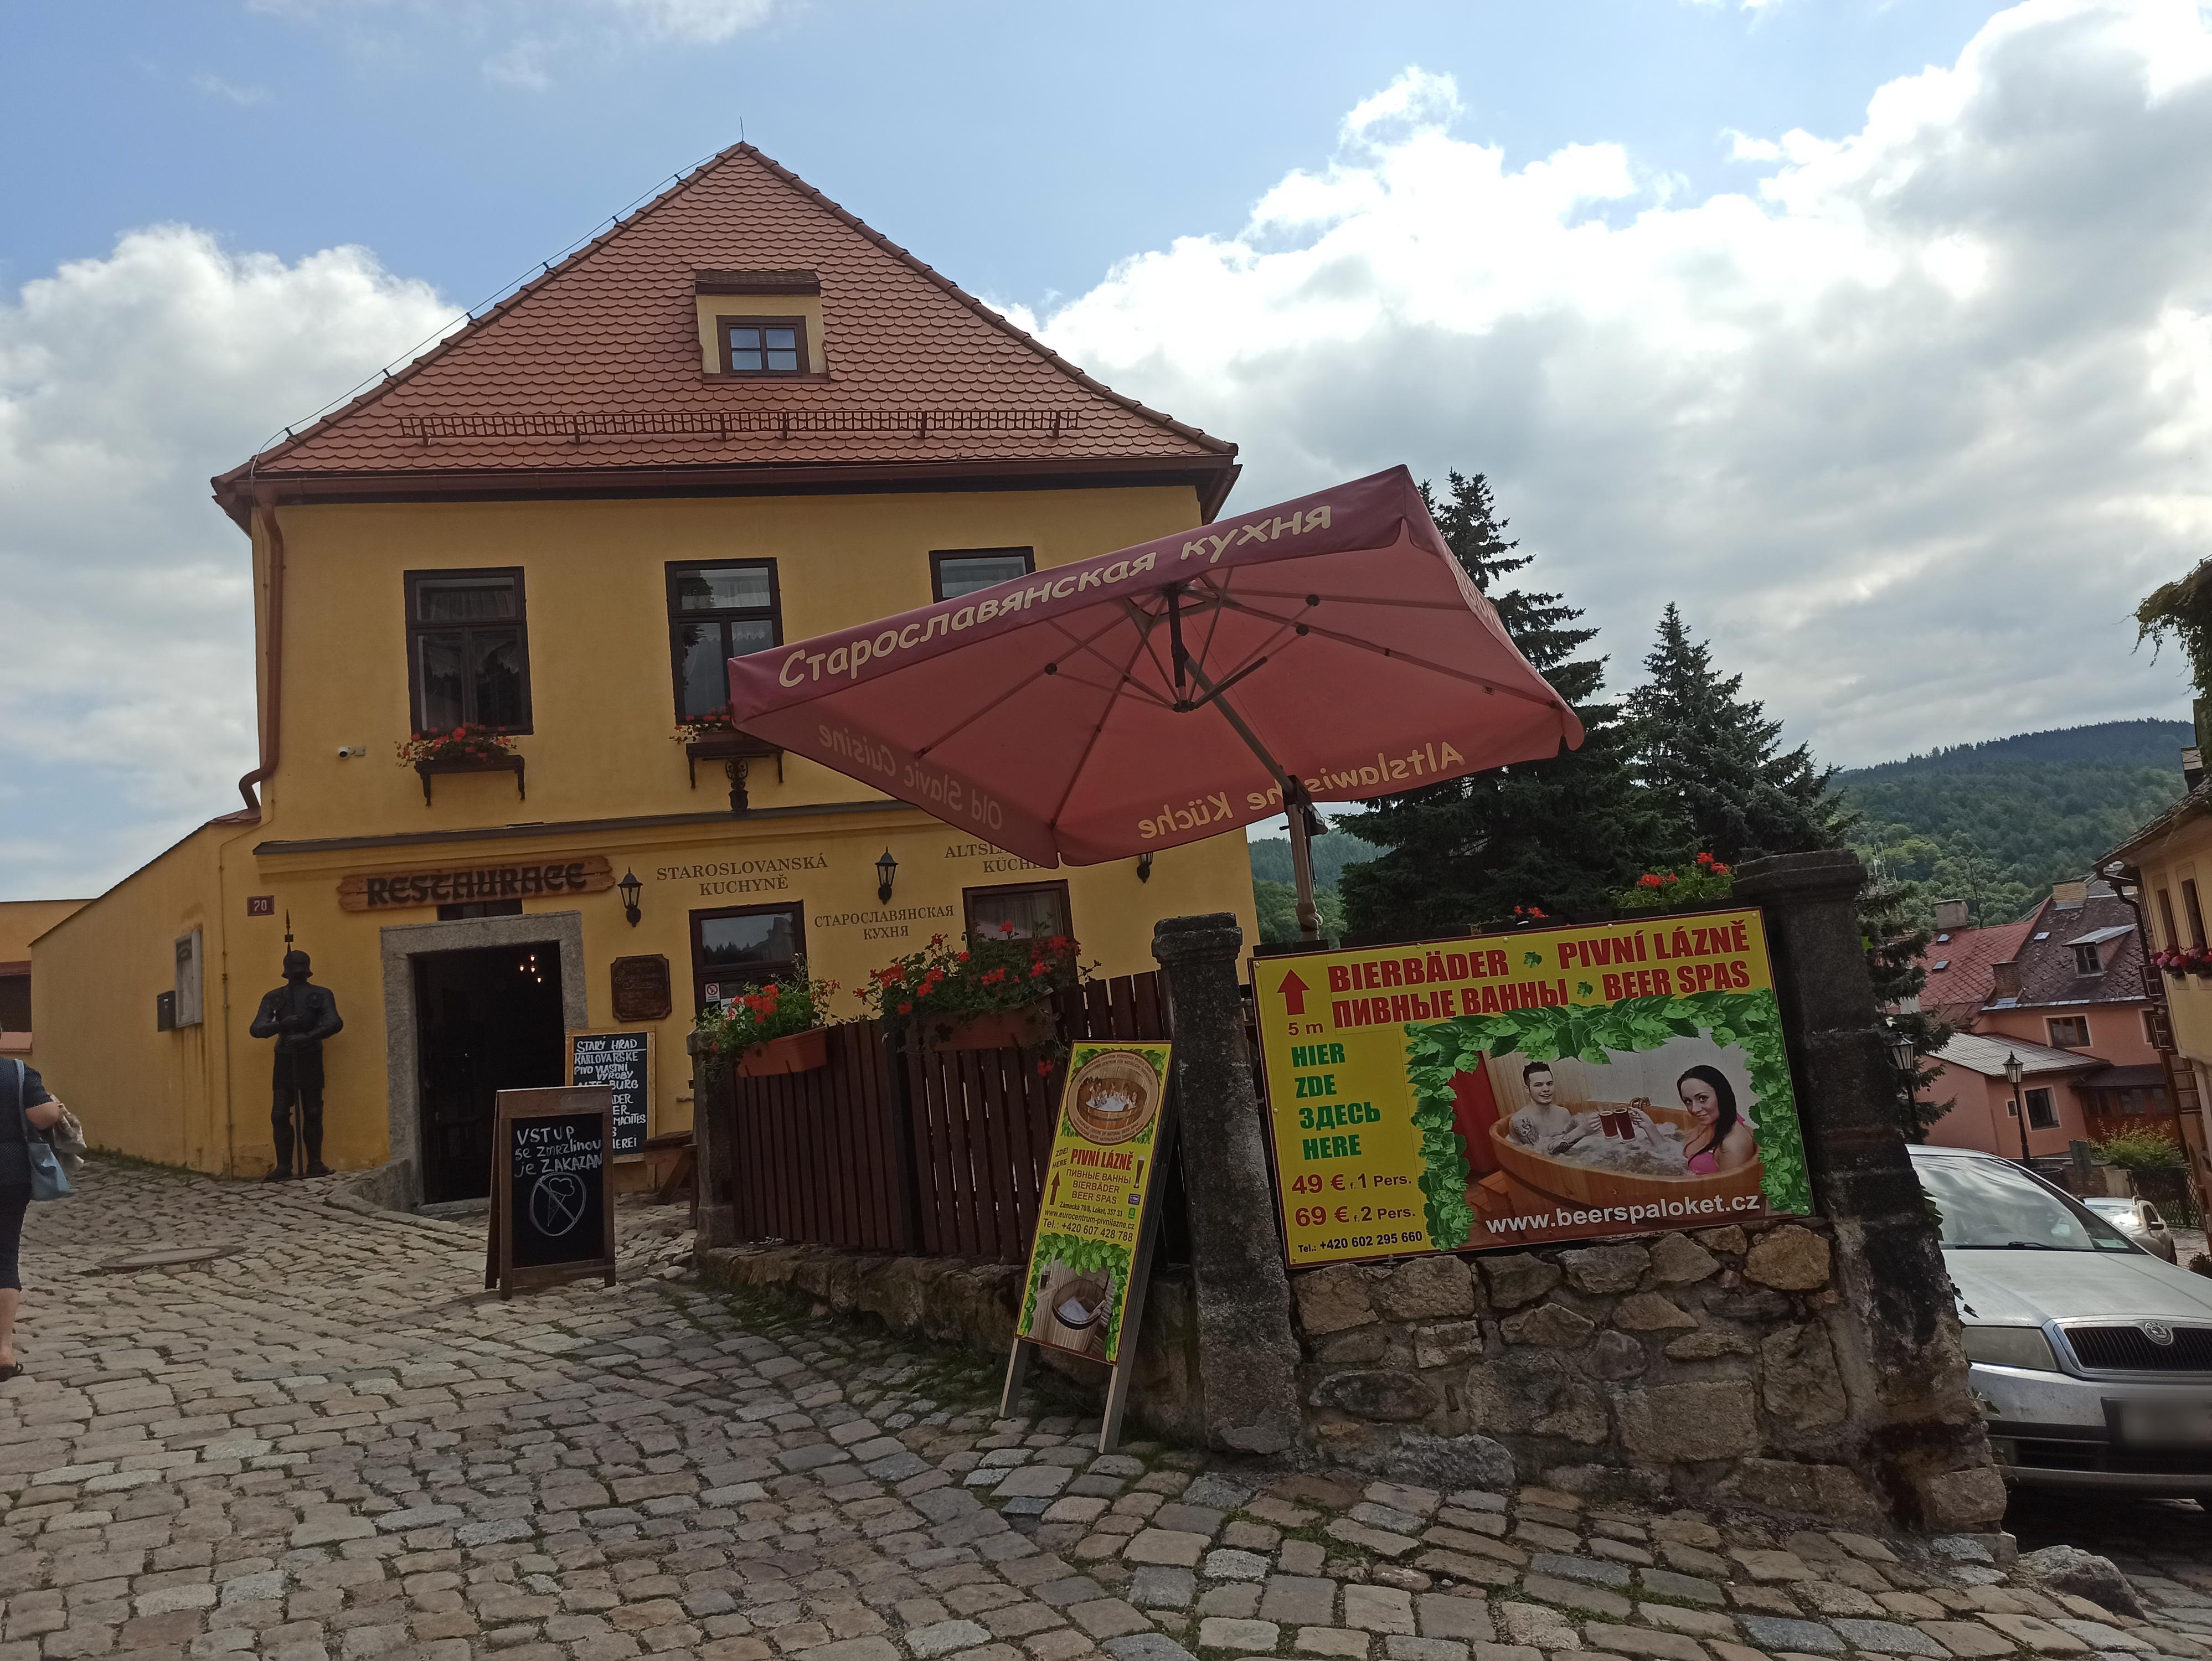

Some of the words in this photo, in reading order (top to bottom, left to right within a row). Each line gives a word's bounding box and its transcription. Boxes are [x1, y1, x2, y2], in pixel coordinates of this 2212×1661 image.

[778, 551, 1157, 688] Старославянская
[1180, 505, 1332, 564] кухня
[657, 853, 828, 881] STAROSLOVANSKÁ
[367, 862, 586, 906] RESTAURACE
[699, 874, 788, 895] KUCHYNĚ
[254, 899, 267, 911] 70
[814, 905, 954, 927] СТАРОСЛАВЯНСКАЯ
[863, 925, 909, 940] КУХНЯ
[1558, 930, 1647, 969] PIVNÍ
[1653, 920, 1750, 960] LÁZNĚ
[1328, 950, 1509, 993] BIERBÄDER
[1602, 968, 1672, 1001] BEER
[1677, 960, 1750, 993] SPAS
[1332, 990, 1456, 1028] ПИВНЫЕ
[1461, 978, 1569, 1015] ВАННЫ
[1288, 1022, 1299, 1036] 5
[1306, 1022, 1324, 1034] m
[611, 1039, 638, 1051] HRAD
[1291, 1043, 1345, 1067] HIER
[609, 1079, 638, 1090] BURG
[1295, 1074, 1337, 1098] ZDE
[612, 1104, 630, 1115] ER
[613, 1113, 646, 1126] MACHTES
[1298, 1102, 1381, 1131] ЗДЕСЬ
[517, 1125, 575, 1146] VSTUP
[1302, 1134, 1362, 1160] HERE
[514, 1161, 537, 1178] je
[1052, 1158, 1068, 1169] HERE
[1070, 1148, 1101, 1167] PIVNÍ
[1100, 1149, 1134, 1171] LÁZNĚ
[1066, 1168, 1100, 1180] ПИВНЫЕ
[1102, 1173, 1131, 1184] ВАННЫ
[1292, 1174, 1322, 1194] 49
[1330, 1174, 1345, 1190] €
[1374, 1175, 1411, 1188] Pers.
[1071, 1191, 1094, 1201] BEER
[1095, 1194, 1117, 1204] SPAS
[1073, 1180, 1120, 1194] BIERBÄDER
[1295, 1206, 1327, 1227] 69
[1334, 1206, 1349, 1223] €
[1378, 1208, 1416, 1220] Pers.
[1486, 1194, 1760, 1234] www.beerspaloket.cz
[1061, 1222, 1081, 1233] +420
[1083, 1225, 1099, 1236] 607
[1100, 1227, 1116, 1239] 428
[1118, 1230, 1133, 1242] 788
[1298, 1244, 1317, 1253] Tel.:
[1320, 1238, 1348, 1250] +420
[1352, 1235, 1373, 1247] 602
[1376, 1233, 1398, 1245] 295
[1401, 1231, 1422, 1242] 660
